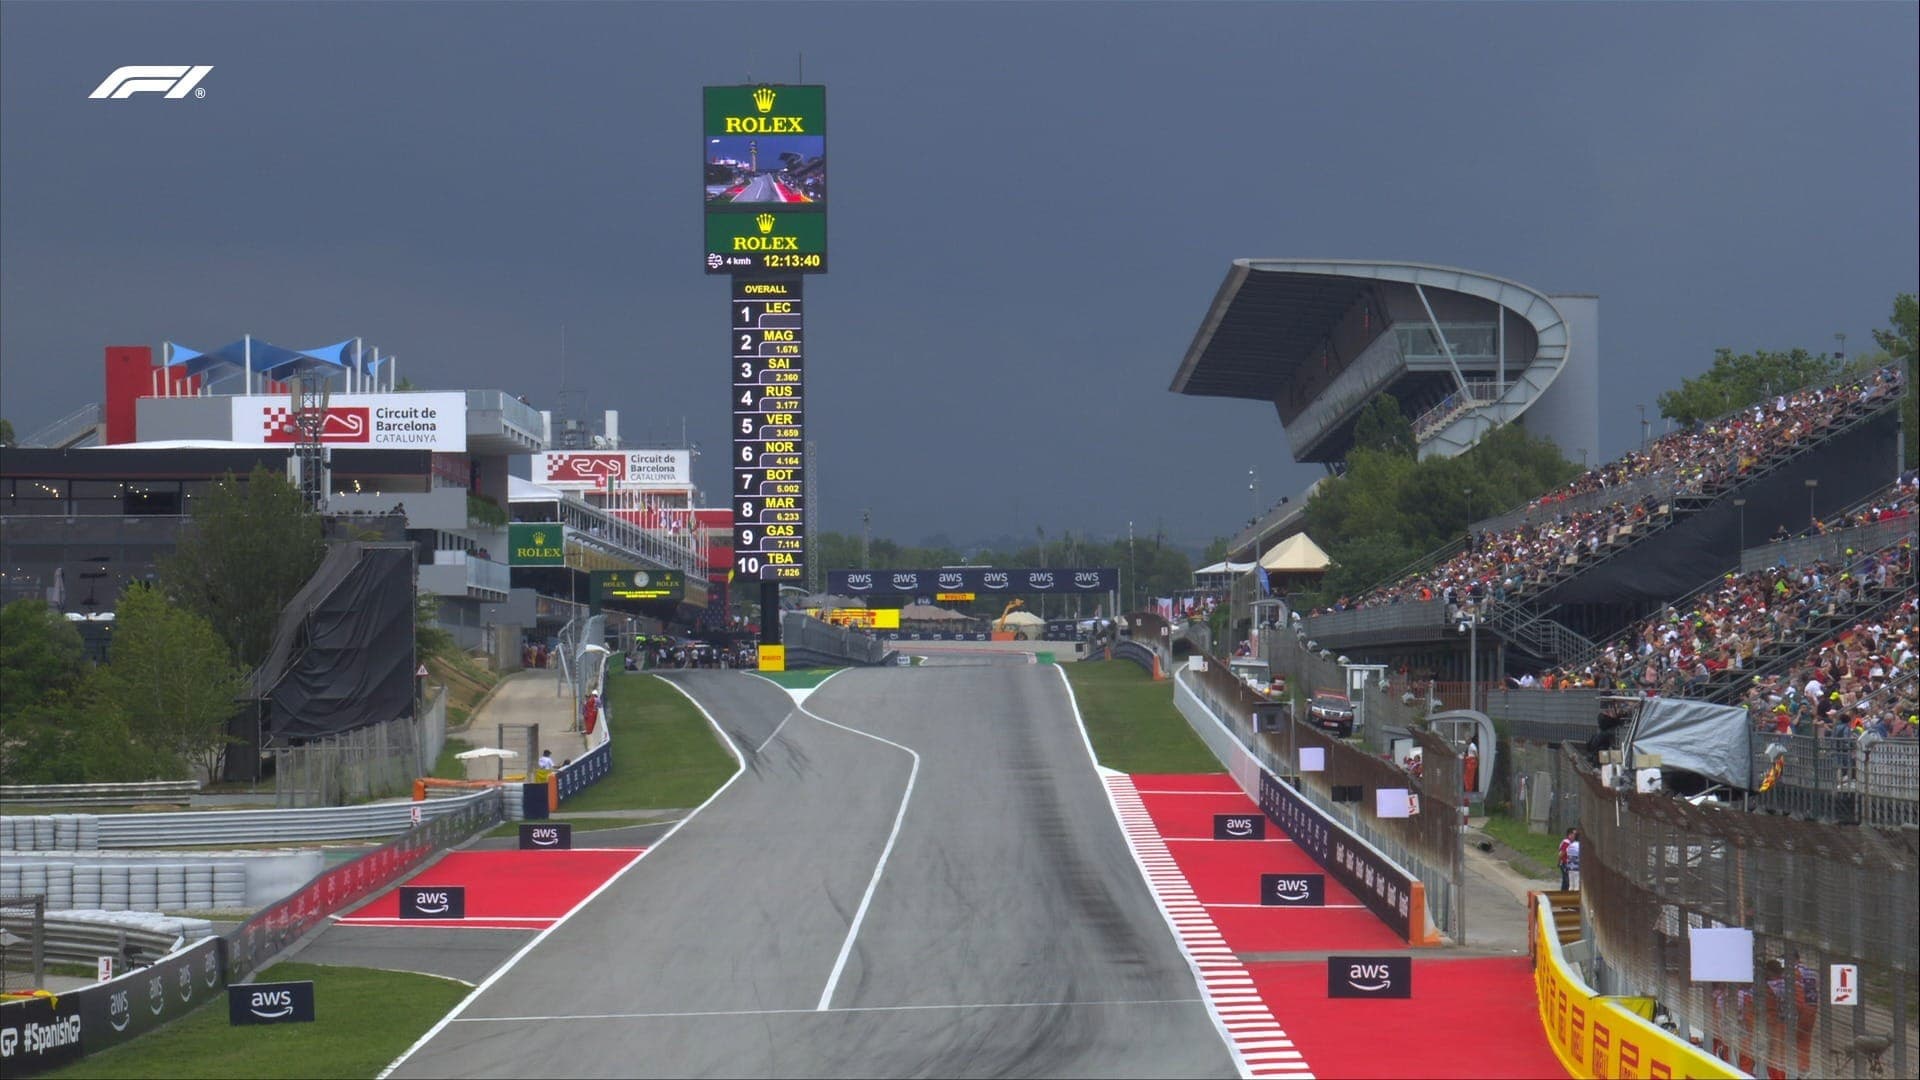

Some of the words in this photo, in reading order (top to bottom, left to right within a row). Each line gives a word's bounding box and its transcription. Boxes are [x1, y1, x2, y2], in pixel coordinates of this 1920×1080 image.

[726, 117, 803, 132] ROLEX
[734, 237, 798, 249] ROLEX
[726, 257, 732, 265] 4
[733, 257, 751, 265] kmh
[764, 255, 820, 266] 12:13:40
[745, 285, 787, 293] OVERALL
[742, 307, 749, 322] 1
[766, 303, 791, 312] LEC
[741, 335, 751, 350] 2
[765, 331, 793, 340] MAG
[742, 363, 752, 377] 3
[769, 359, 789, 368] SAI
[741, 391, 752, 405] 4
[767, 386, 792, 396] RUS
[376, 408, 419, 418] Circuit
[421, 408, 437, 418] de
[376, 421, 437, 431] Barcelona
[742, 419, 752, 433] 5
[767, 414, 792, 424] VER
[375, 434, 437, 443] CATALUNYA
[742, 447, 752, 461] 6
[766, 442, 793, 452] NOR
[630, 454, 663, 463] Circuit
[664, 454, 676, 463] de
[630, 464, 676, 472] Barcelona
[630, 473, 676, 481] CATALUNYA
[743, 474, 752, 489] 7
[767, 470, 793, 480] BOT
[743, 502, 752, 517] 8
[766, 497, 795, 508] MAR
[743, 530, 753, 544] 9
[767, 526, 794, 536] GAS
[516, 547, 562, 558] ROLEX
[738, 558, 758, 573] 10
[768, 553, 793, 563] TBA
[848, 574, 871, 583] aws
[893, 573, 916, 584] aws
[939, 573, 961, 582] aws
[984, 572, 1008, 583] aws
[1030, 572, 1053, 581] aws
[1075, 571, 1098, 581] aws
[1226, 819, 1252, 829] aws
[532, 828, 557, 839] aws
[1277, 879, 1308, 892] aws
[416, 892, 448, 905] aws
[1351, 965, 1388, 978] aws
[150, 976, 162, 999] aws
[110, 990, 129, 1014] aws
[251, 991, 292, 1008] aws
[24, 1014, 81, 1055] #SpanishGP
